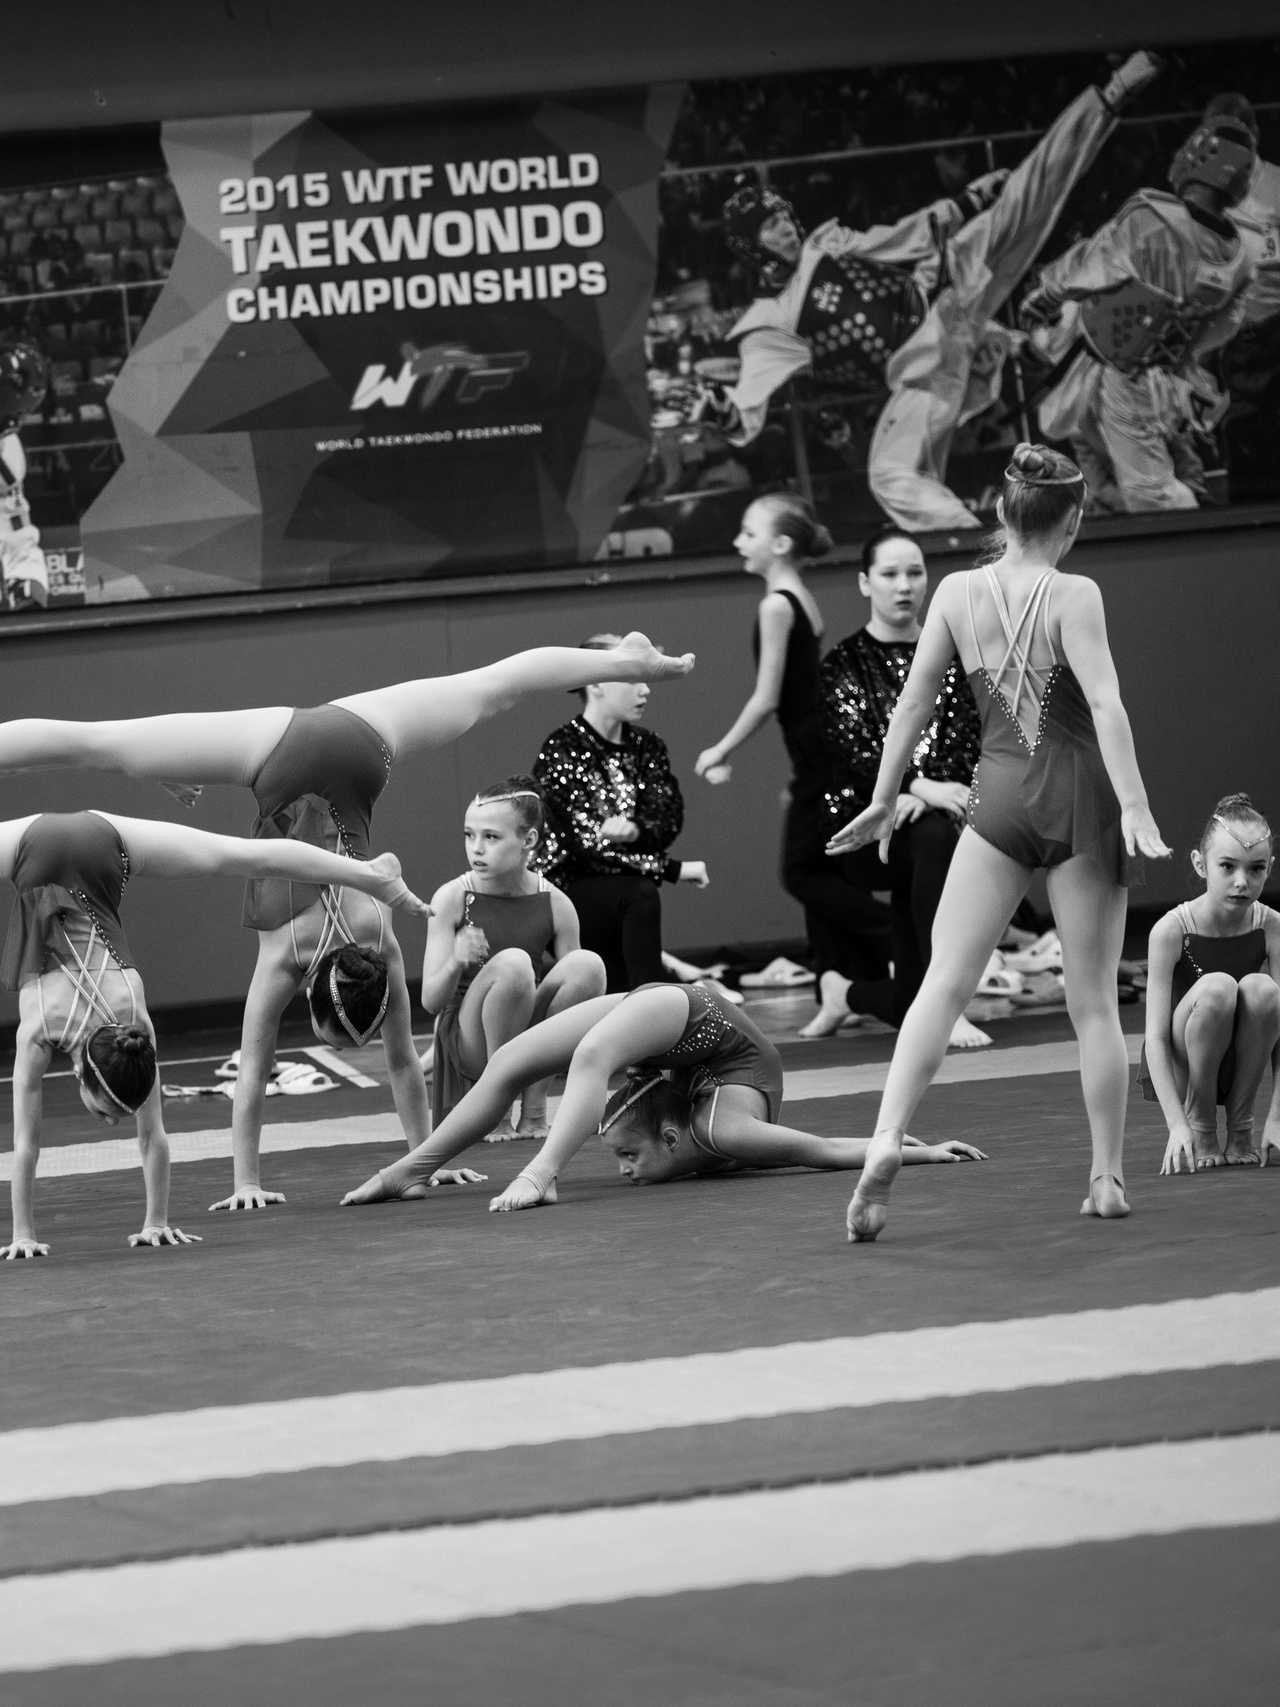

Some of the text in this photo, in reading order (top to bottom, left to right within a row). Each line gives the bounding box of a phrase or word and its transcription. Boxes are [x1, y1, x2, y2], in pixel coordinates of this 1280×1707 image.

[219, 153, 600, 215] 2015 WTF WORLD
[220, 200, 605, 274] TAEKWONDO
[225, 261, 608, 323] CHAMPIONSHIPS
[349, 342, 532, 413] WTF
[315, 423, 542, 453] WORLD TAEKWONDO FEDERATION
